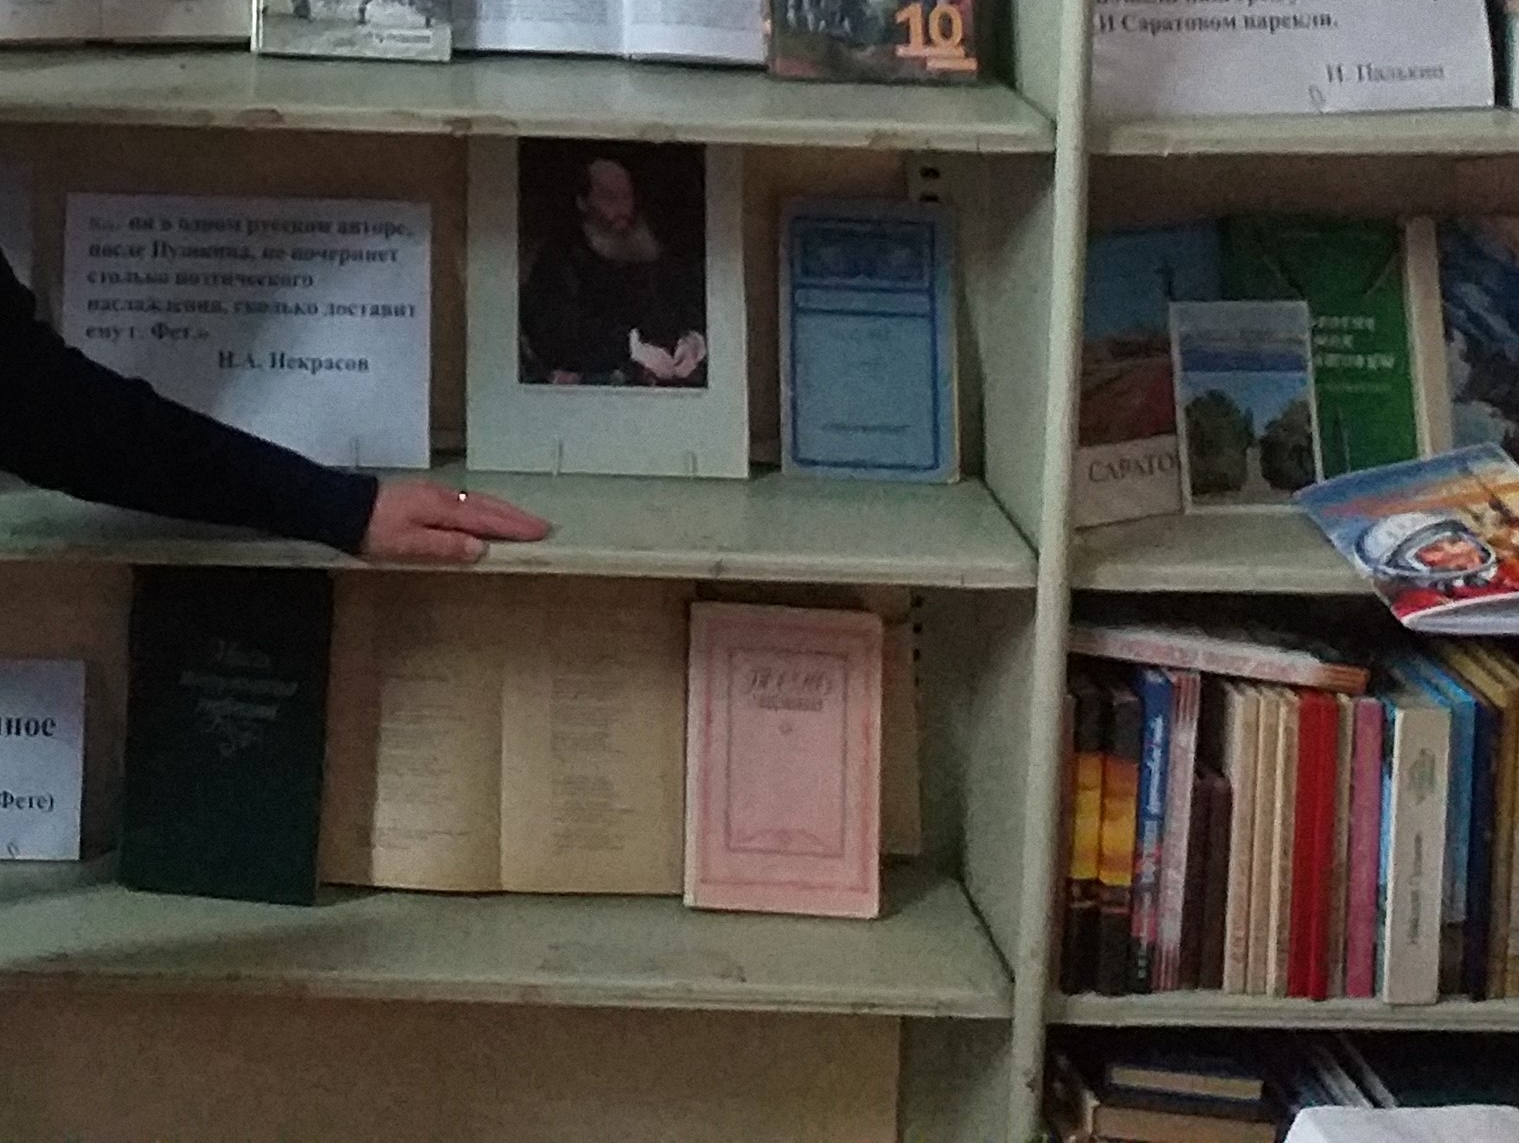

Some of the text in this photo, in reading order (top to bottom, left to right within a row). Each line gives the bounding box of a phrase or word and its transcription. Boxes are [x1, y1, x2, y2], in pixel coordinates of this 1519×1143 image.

[895, 3, 963, 50] 10
[1098, 13, 1115, 34] И
[1121, 13, 1236, 38] Саратовом
[269, 351, 370, 376] Некрасов
